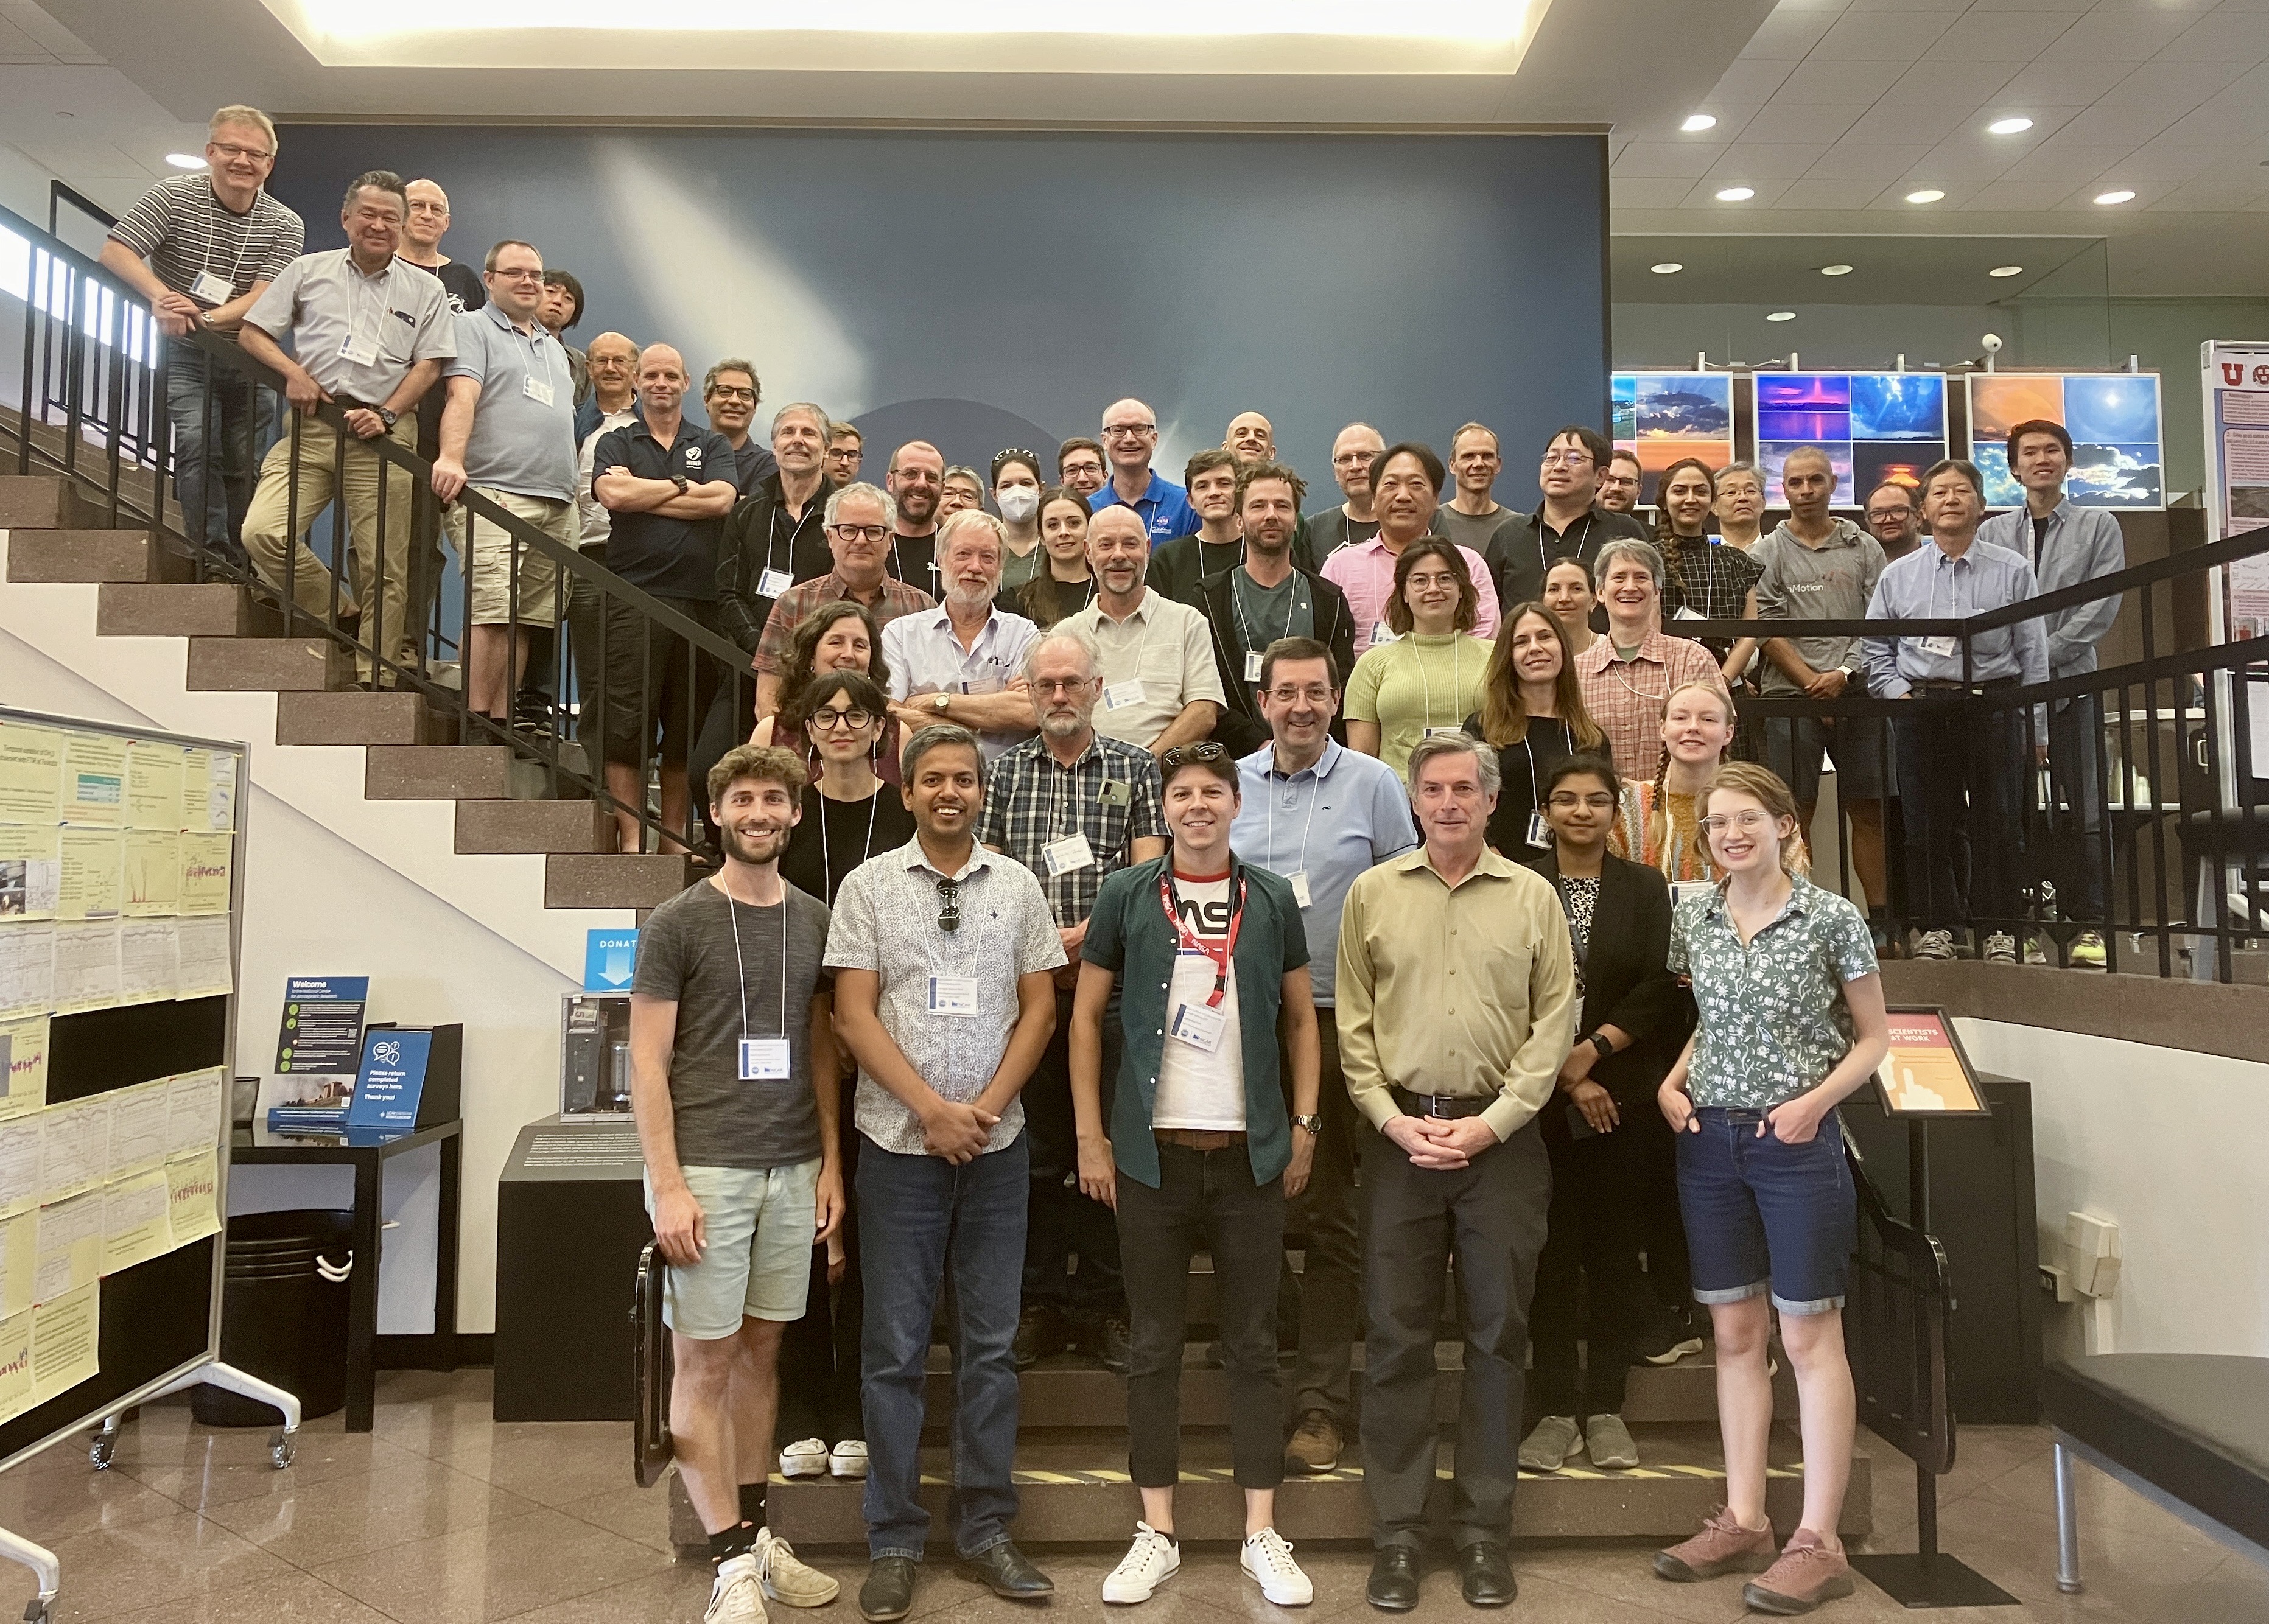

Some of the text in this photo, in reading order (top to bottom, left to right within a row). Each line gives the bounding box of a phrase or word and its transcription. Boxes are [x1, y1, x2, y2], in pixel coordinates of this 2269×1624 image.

[2221, 363, 2243, 386] U
[1162, 894, 1174, 914] NASA
[600, 940, 637, 948] DONAT
[1191, 938, 1210, 956] NASA
